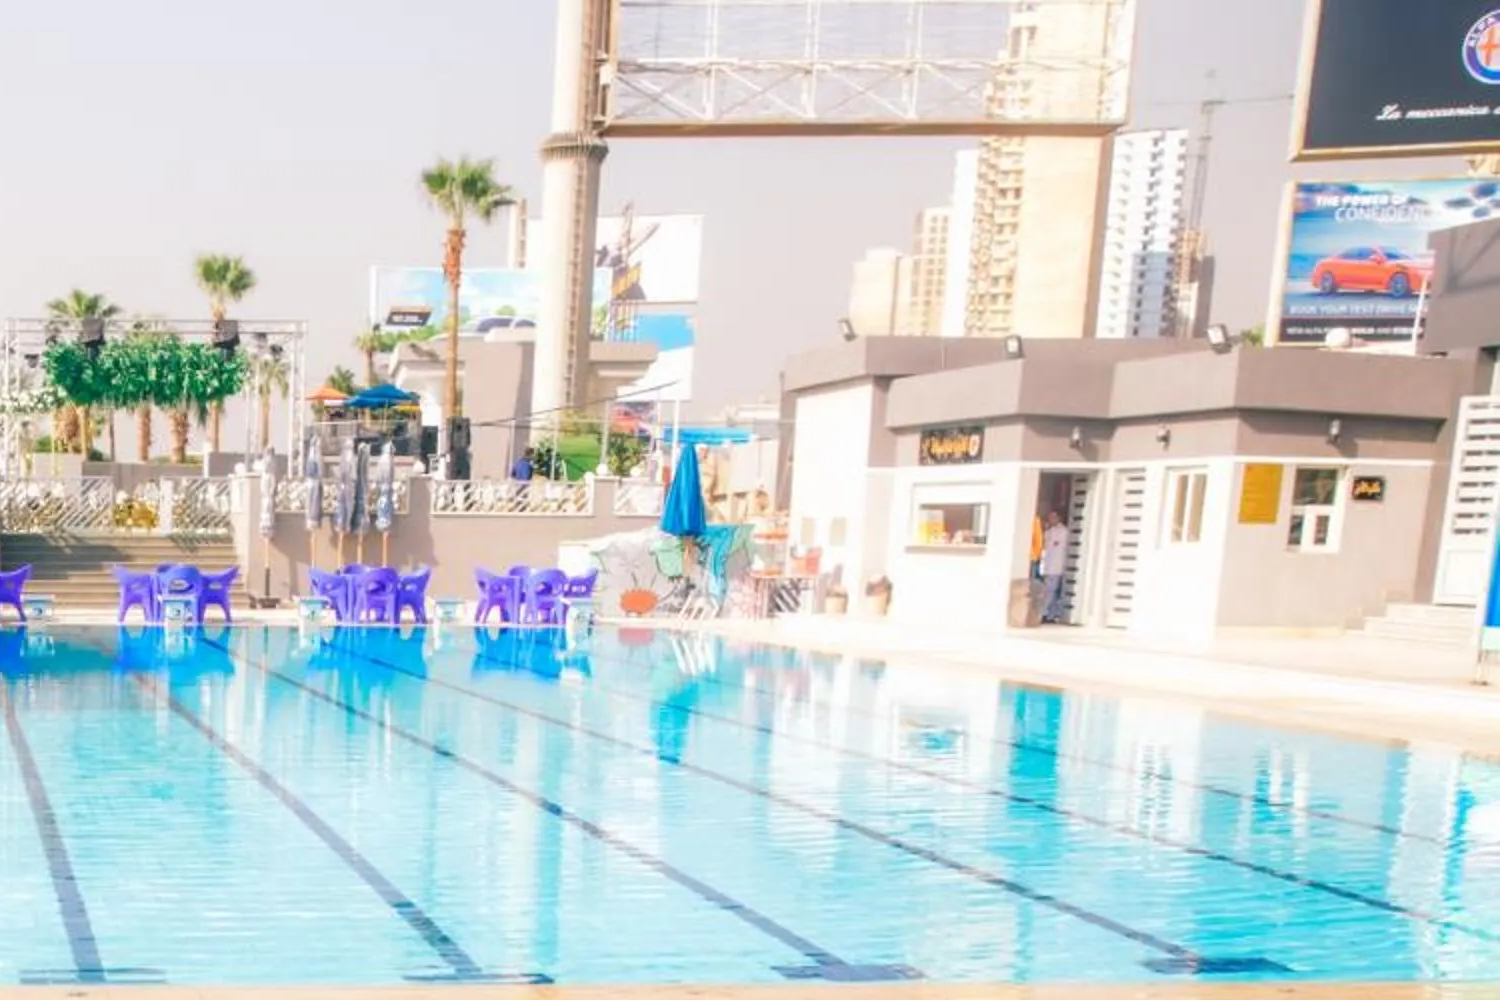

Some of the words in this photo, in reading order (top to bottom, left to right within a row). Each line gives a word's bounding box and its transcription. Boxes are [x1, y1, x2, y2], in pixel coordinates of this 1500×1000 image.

[1375, 103, 1404, 121] La
[1316, 194, 1340, 207] THE
[1342, 193, 1389, 206] POWER
